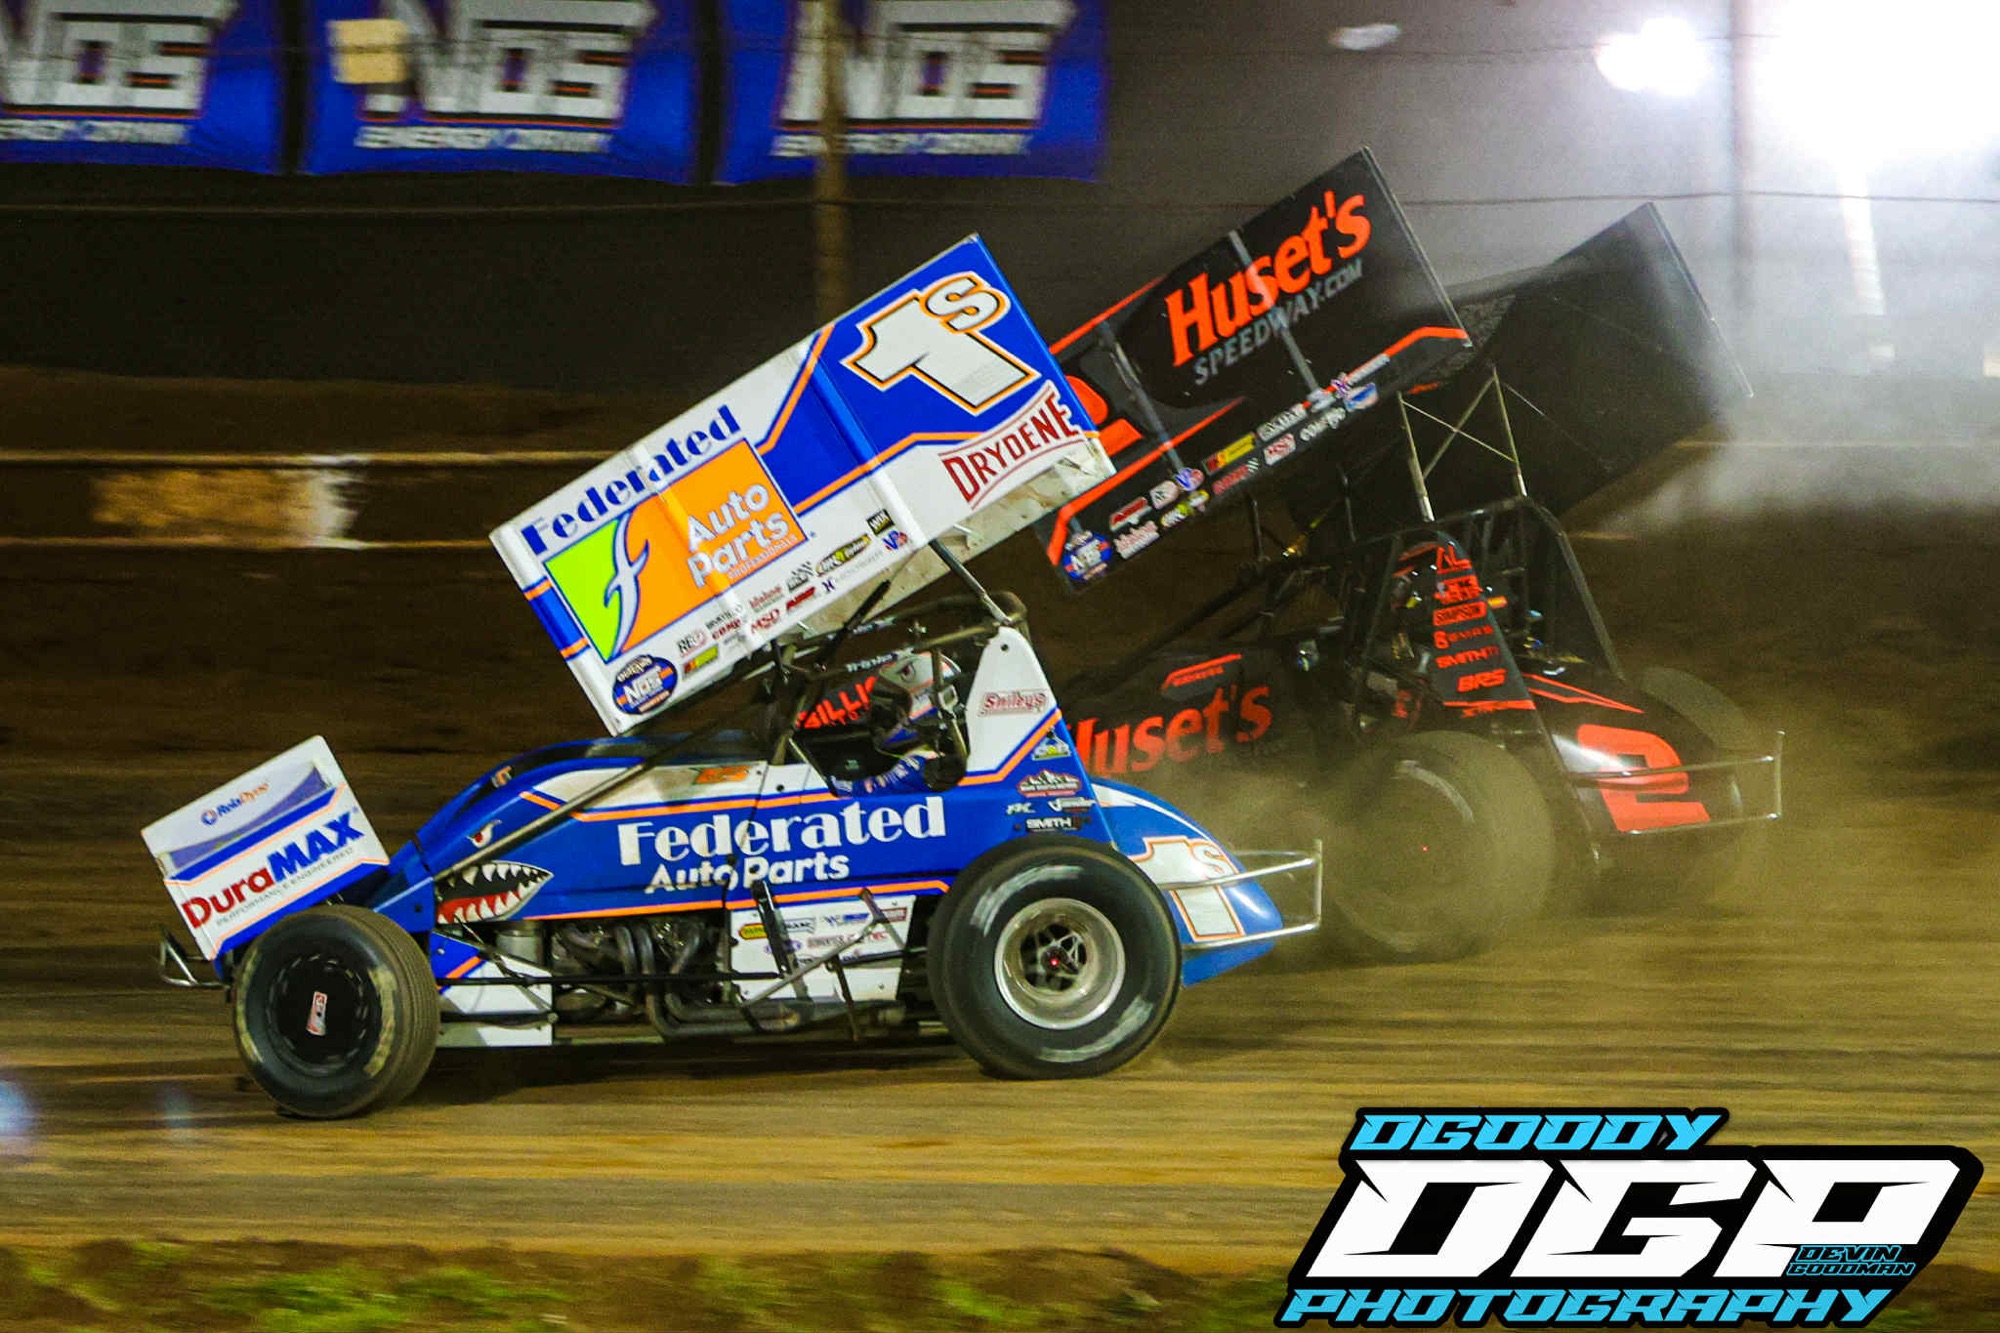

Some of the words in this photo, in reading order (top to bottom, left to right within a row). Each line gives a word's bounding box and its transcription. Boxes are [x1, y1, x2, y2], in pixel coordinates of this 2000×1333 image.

[1164, 190, 1372, 368] Huset's
[1194, 258, 1364, 386] SPEEDWAY.COM
[520, 404, 741, 556] Federated
[942, 392, 1079, 502] DRYDENE
[686, 483, 770, 553] Auto
[687, 510, 790, 588] Parts
[181, 811, 365, 929] DuraMAX
[618, 797, 946, 866] Federated
